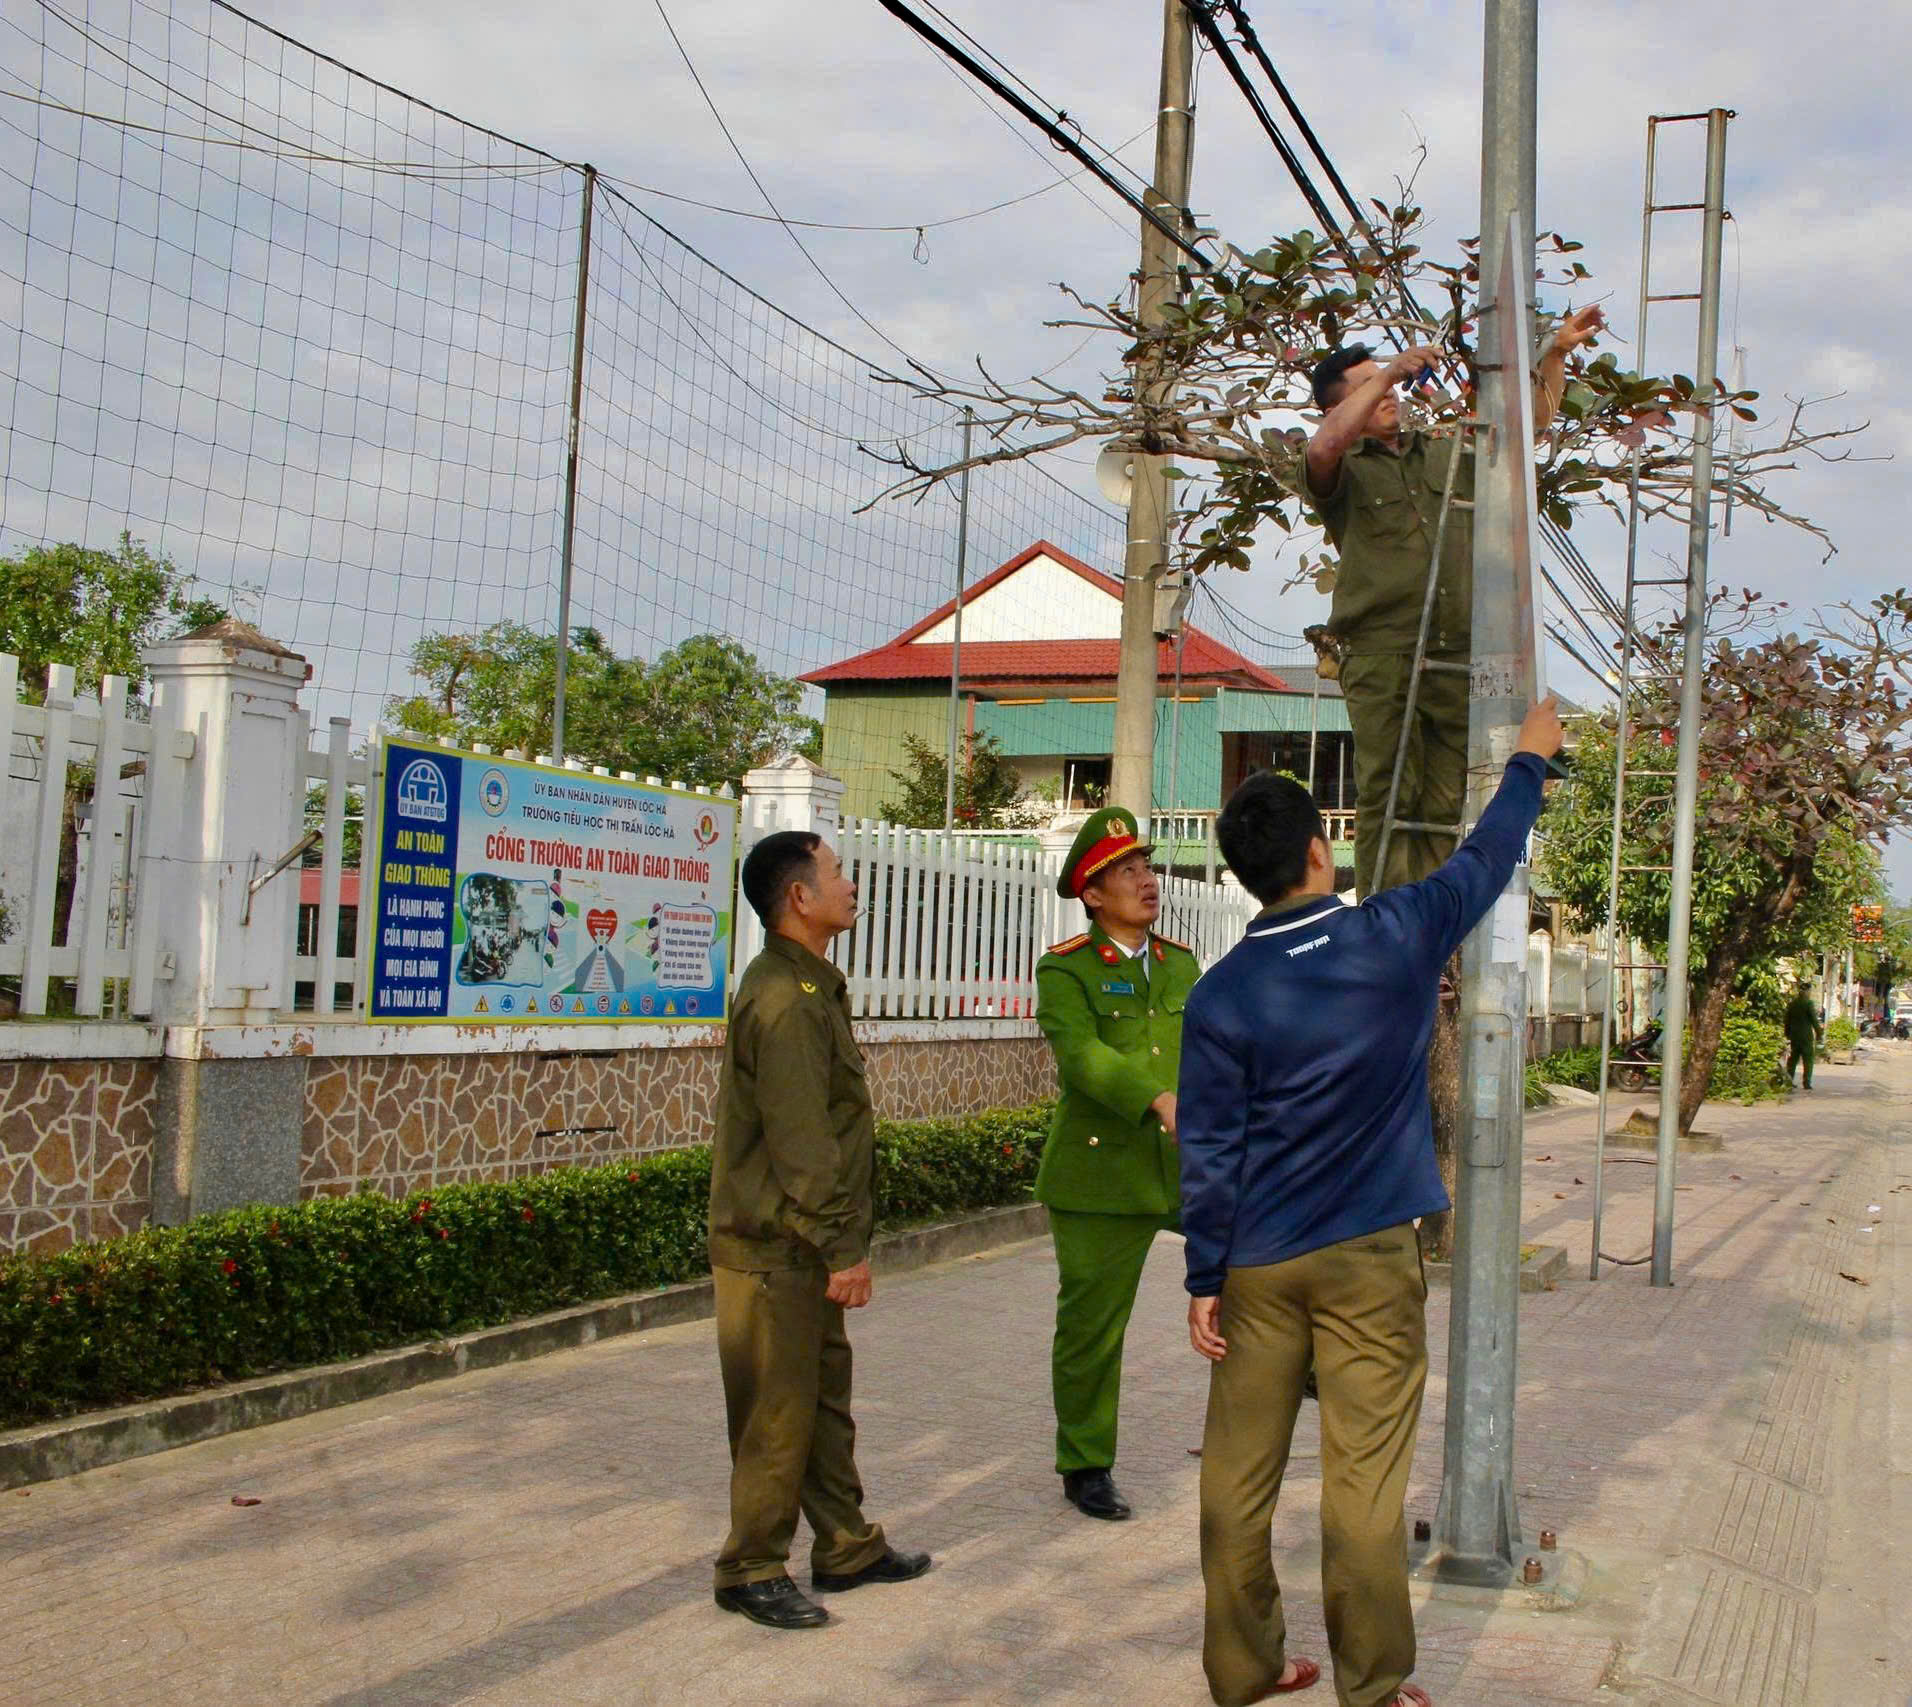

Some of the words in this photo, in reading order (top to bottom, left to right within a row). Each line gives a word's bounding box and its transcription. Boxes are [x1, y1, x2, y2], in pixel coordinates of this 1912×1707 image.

[548, 786, 565, 799] BAN
[568, 788, 591, 803] NHÂN
[593, 792, 610, 806] DÂN
[584, 816, 603, 831] HỌC
[606, 819, 619, 834] THỊ
[620, 818, 643, 835] TRẤN
[396, 830, 413, 851] AN
[416, 829, 445, 854] TOÀN
[486, 826, 525, 863] CỔNG
[530, 837, 582, 869] TRƯỜNG
[586, 848, 604, 873] AN
[608, 848, 640, 876] TOÀN
[643, 855, 669, 880] GIAO
[673, 856, 710, 884] THÔNG
[385, 862, 412, 884] GIAO
[415, 863, 451, 888] THÔNG
[387, 894, 398, 915] LÀ
[399, 898, 422, 920] HẠNH
[423, 897, 445, 919] PHÚC
[383, 922, 400, 947] CỦA
[402, 929, 419, 951] MỌI
[386, 959, 402, 981] MỌI
[404, 960, 418, 977] GIA
[419, 956, 439, 978] ĐÌNH
[380, 986, 391, 1007] VÀ
[393, 986, 414, 1007] TOÀN
[415, 987, 426, 1007] XÃ
[427, 987, 442, 1011] HỘI
